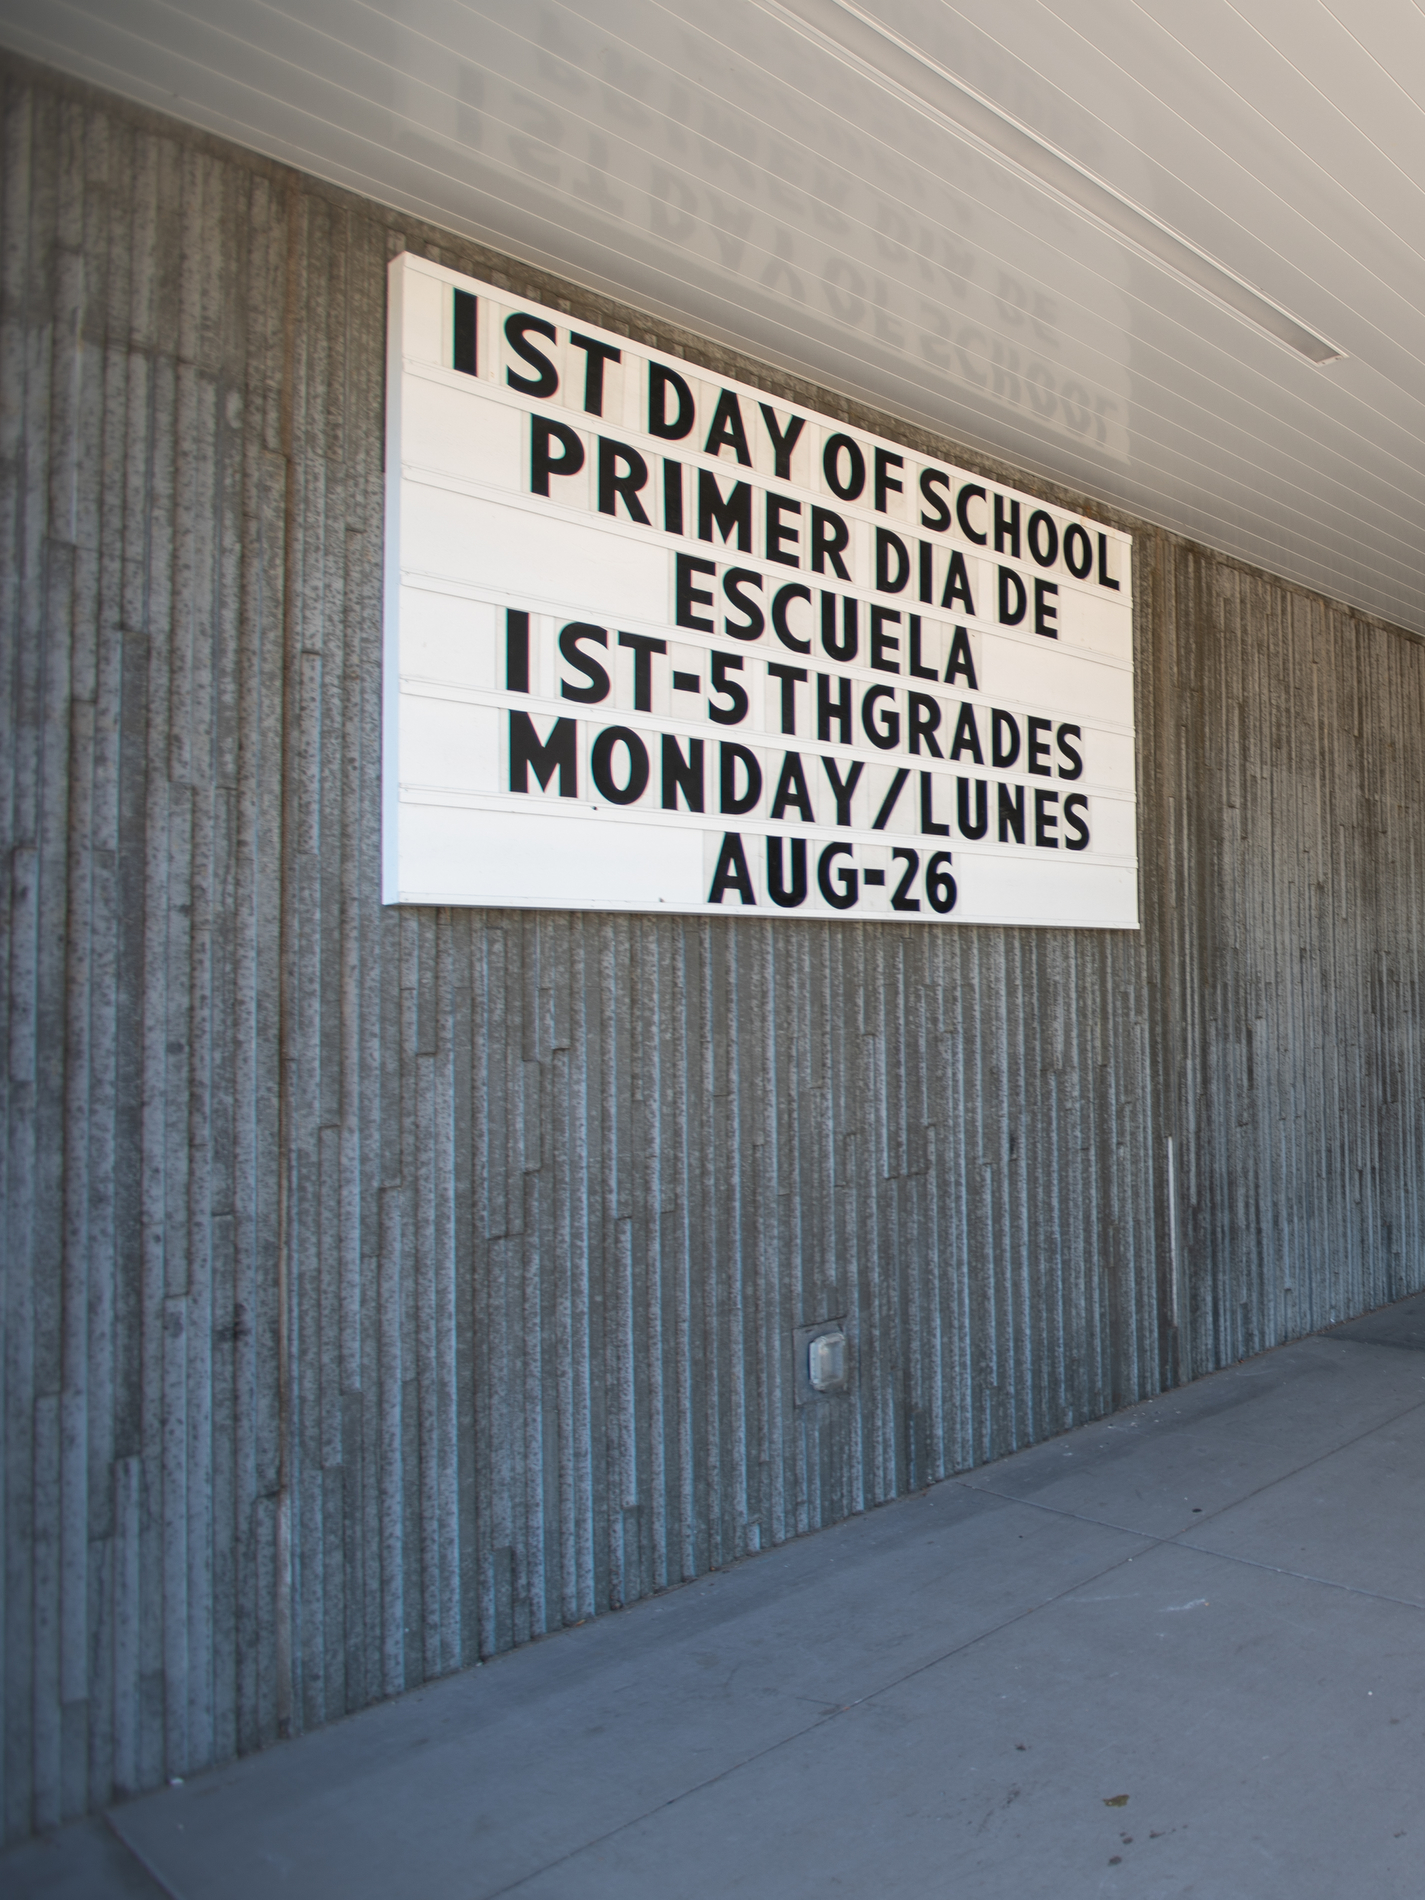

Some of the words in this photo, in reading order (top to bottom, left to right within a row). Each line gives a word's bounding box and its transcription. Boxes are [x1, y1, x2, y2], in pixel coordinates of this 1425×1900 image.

[531, 413, 853, 582] PRIMER
[875, 526, 976, 616] DIA
[998, 564, 1060, 640] DE
[648, 359, 807, 481] DAY
[822, 433, 904, 514] OF
[919, 467, 1120, 592] SCHOOL
[676, 552, 979, 691] ESCUELA
[509, 709, 1090, 852] MONDAY/LUNES
[707, 831, 957, 914] AUG-26
